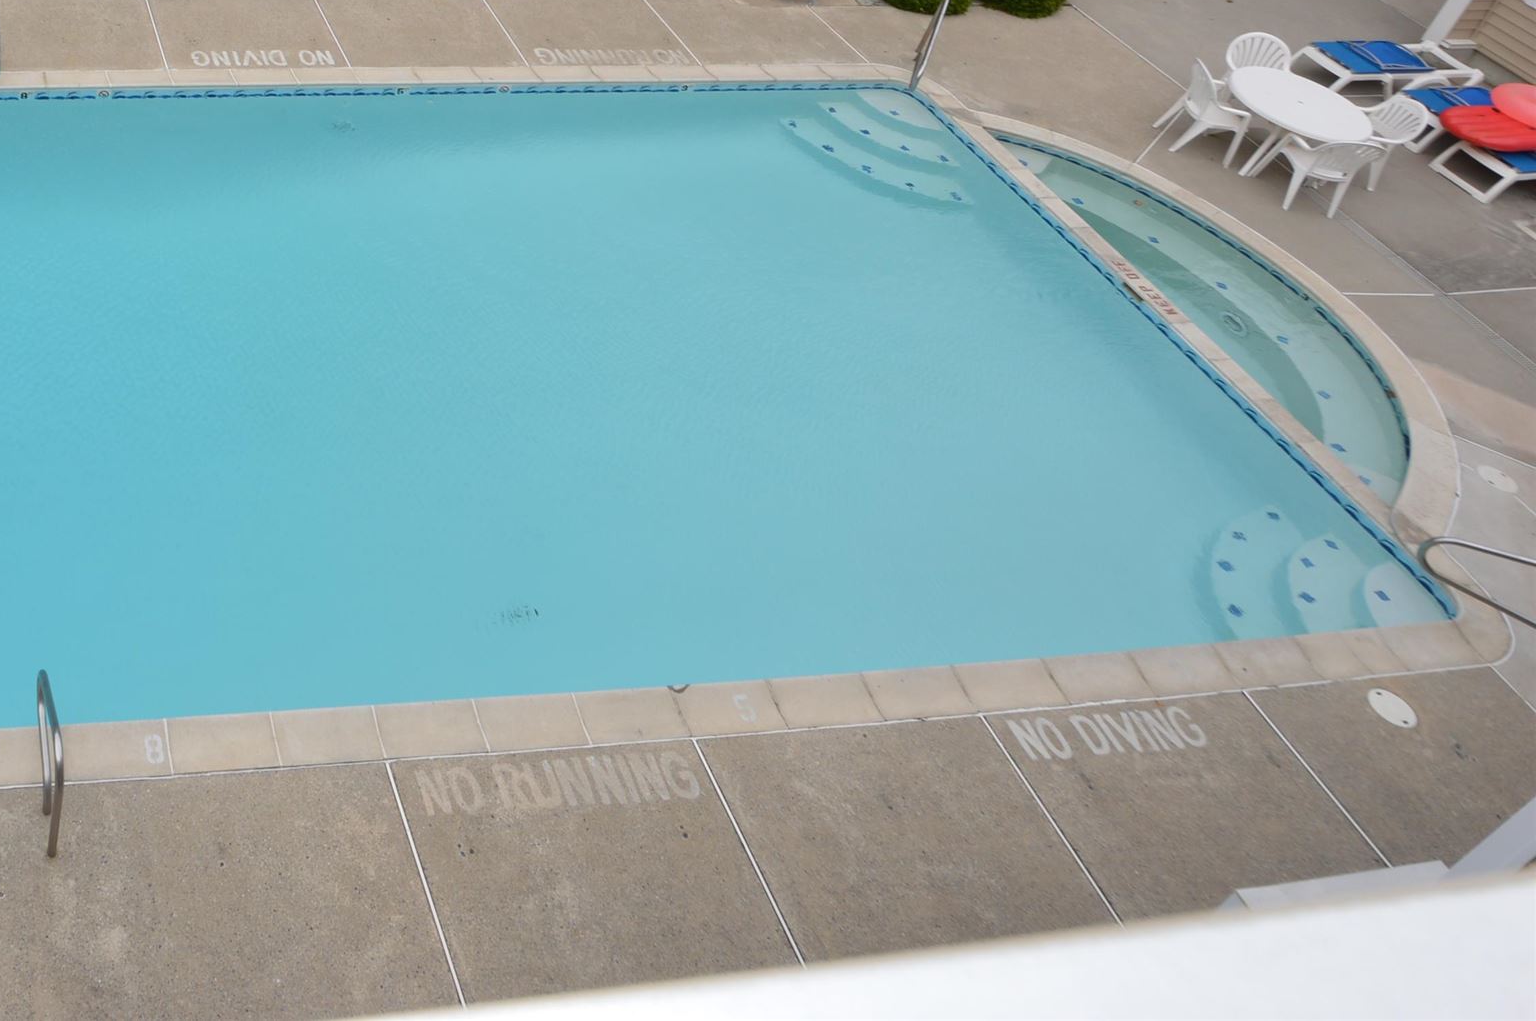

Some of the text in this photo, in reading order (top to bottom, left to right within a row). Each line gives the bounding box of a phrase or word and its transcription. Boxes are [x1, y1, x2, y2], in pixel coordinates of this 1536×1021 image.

[191, 49, 336, 67] NO DIVING
[1111, 259, 1179, 316] KEEP OFF
[144, 734, 165, 764] 8
[1005, 705, 1208, 762] NO DIVING
[413, 750, 701, 817] NO RUNNING
